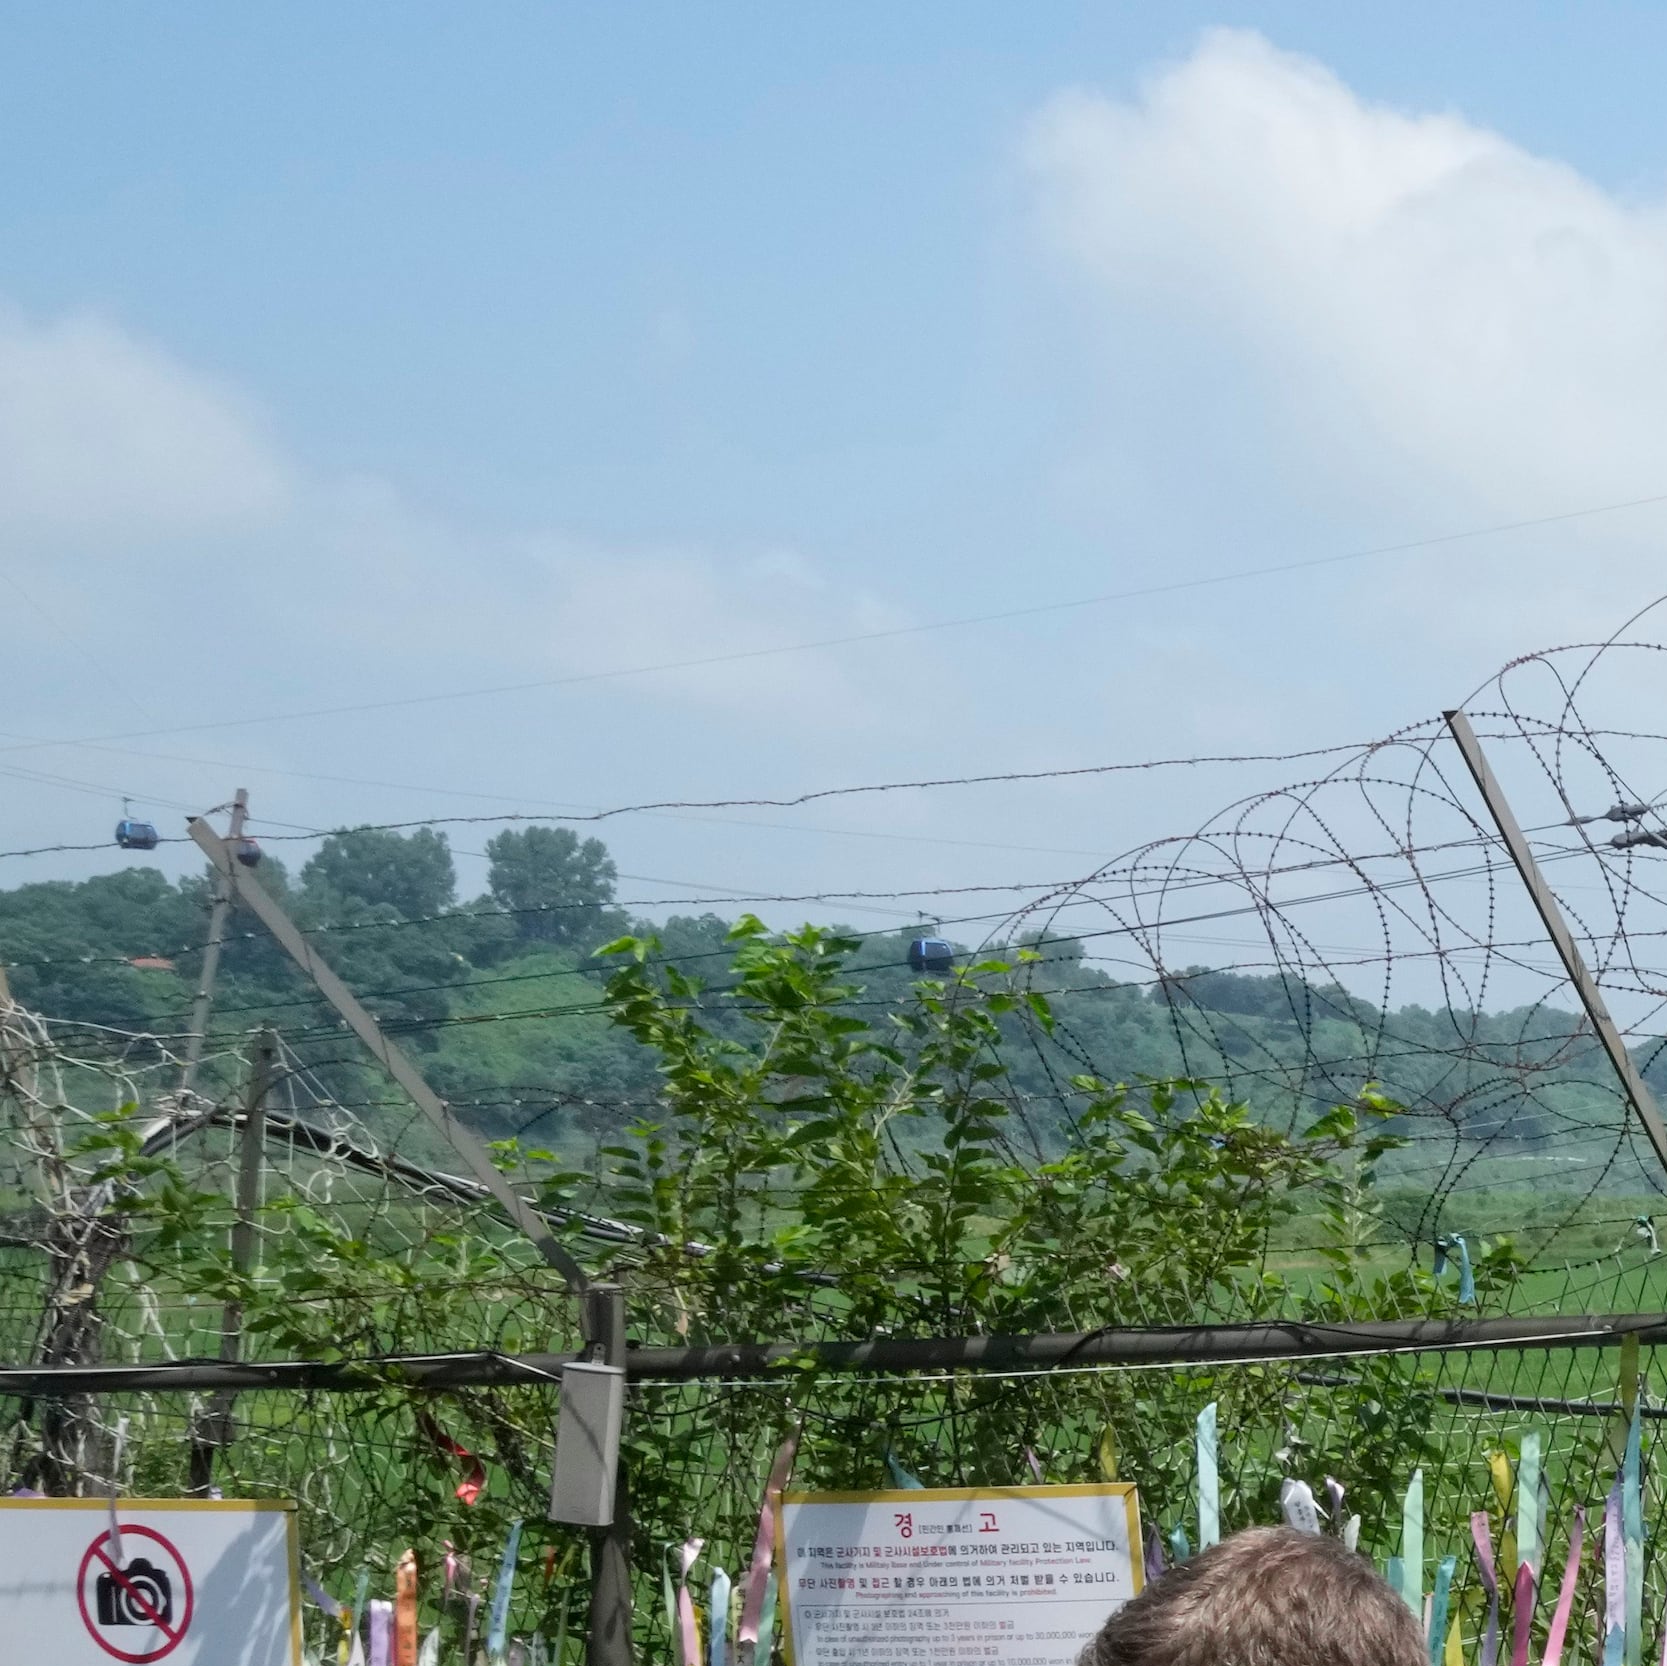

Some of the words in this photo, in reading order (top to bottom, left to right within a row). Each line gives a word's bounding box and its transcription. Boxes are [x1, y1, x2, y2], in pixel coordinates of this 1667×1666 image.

[893, 1512, 913, 1538] 경
[976, 1512, 1000, 1532] 고
[959, 1541, 998, 1556] 의거하여
[999, 1540, 1040, 1555] 관리되고
[1041, 1540, 1063, 1554] 있는
[984, 1574, 1005, 1586] 의거
[1057, 1573, 1069, 1585] 수
